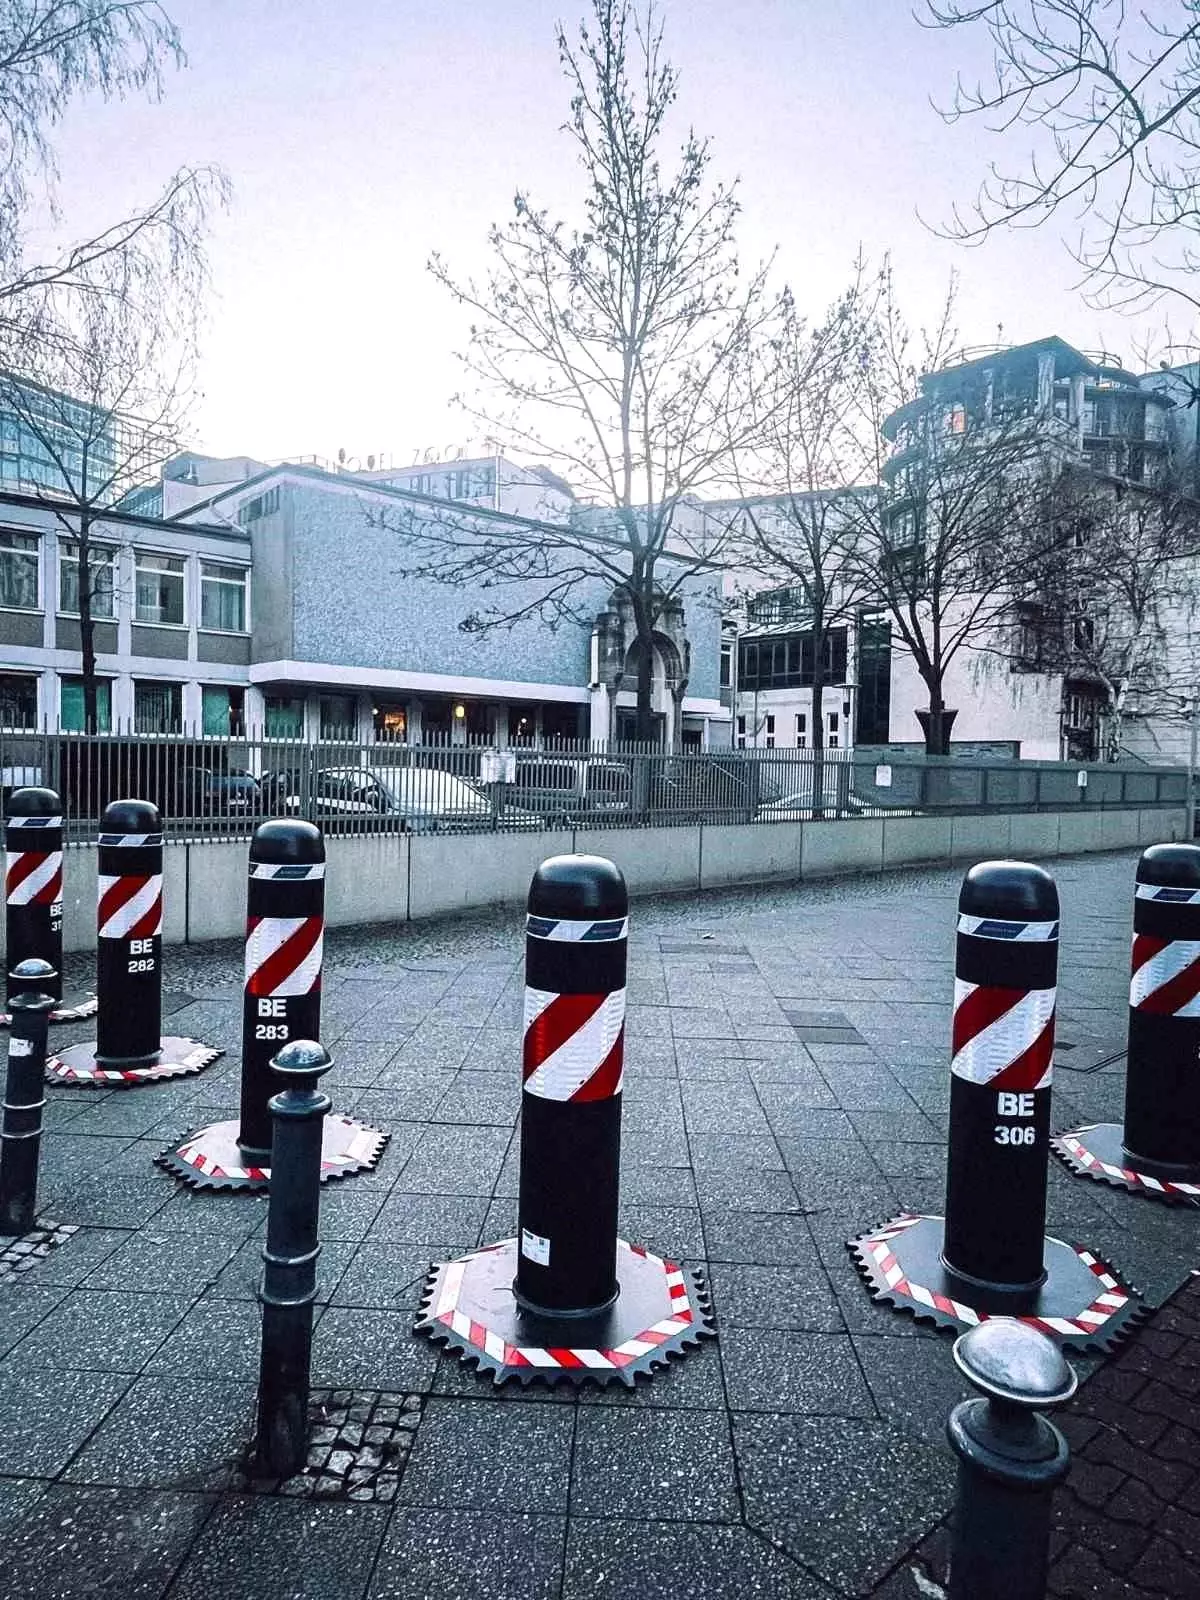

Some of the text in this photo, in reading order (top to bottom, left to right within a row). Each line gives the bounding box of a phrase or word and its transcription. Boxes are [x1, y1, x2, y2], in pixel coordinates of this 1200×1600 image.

[50, 903, 63, 917] BE
[130, 938, 153, 955] BE
[128, 958, 155, 973] 282
[258, 998, 287, 1017] BE
[255, 1024, 289, 1040] 283
[997, 1092, 1035, 1117] BE
[994, 1125, 1036, 1146] 306
